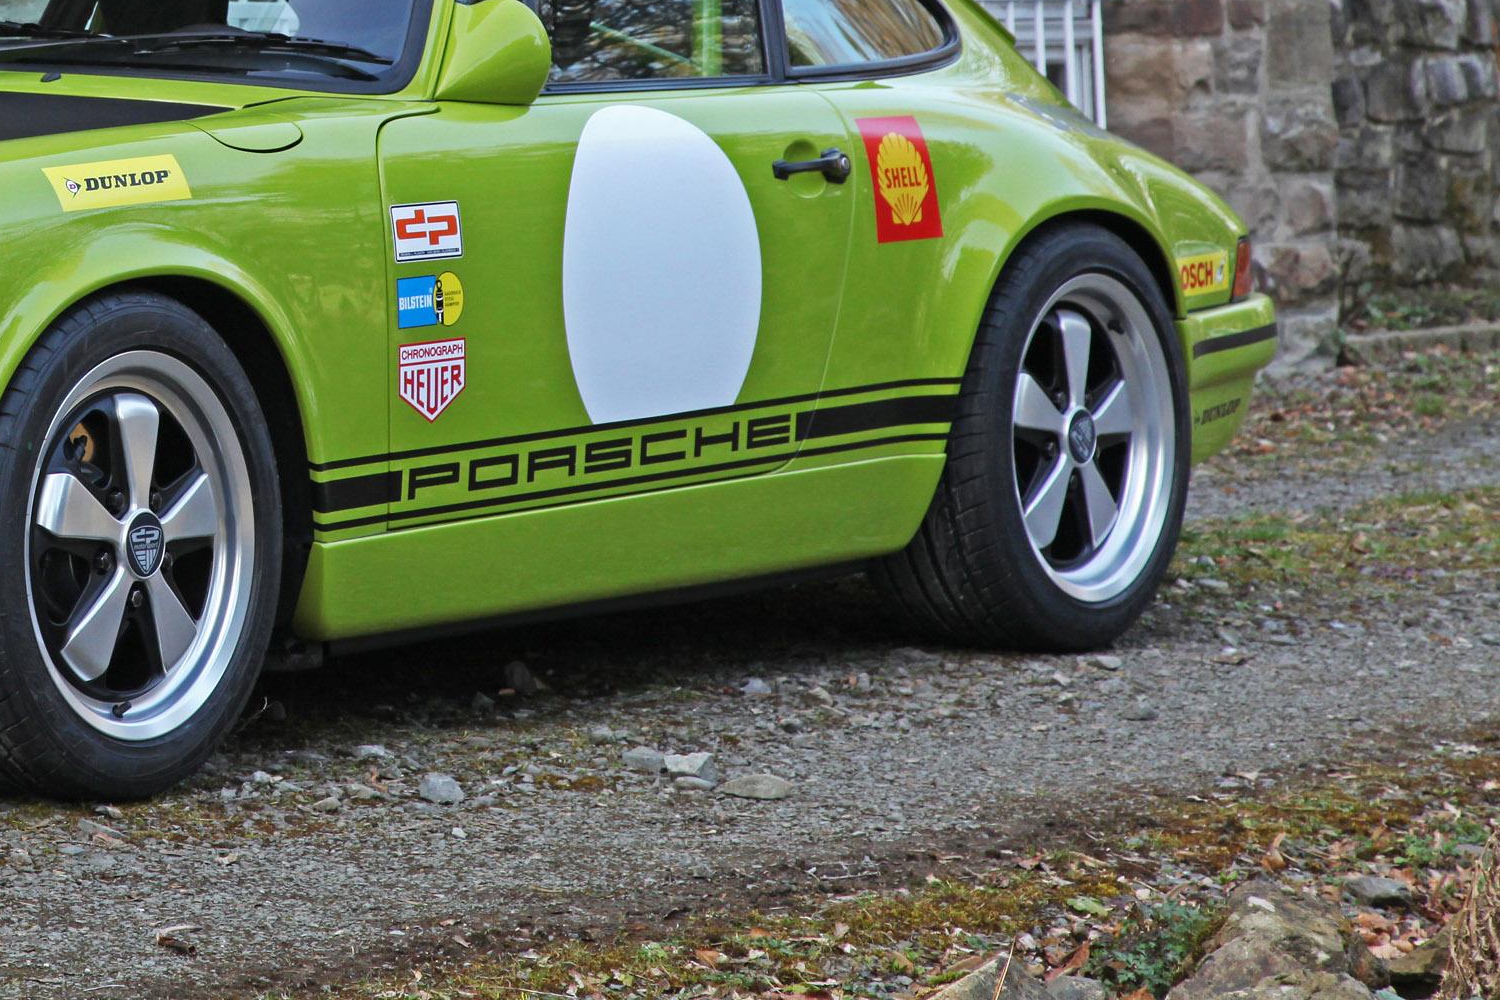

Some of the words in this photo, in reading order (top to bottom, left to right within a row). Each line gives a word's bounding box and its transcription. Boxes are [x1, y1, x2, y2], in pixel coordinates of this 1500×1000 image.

[84, 170, 169, 191] DUNLOP
[885, 166, 921, 188] SHELL
[1181, 261, 1213, 290] OSCH
[398, 294, 432, 310] BILSTEIN
[401, 344, 463, 360] CHRONOGRAPH
[404, 365, 461, 414] HEUER
[407, 413, 791, 500] PORSCHE
